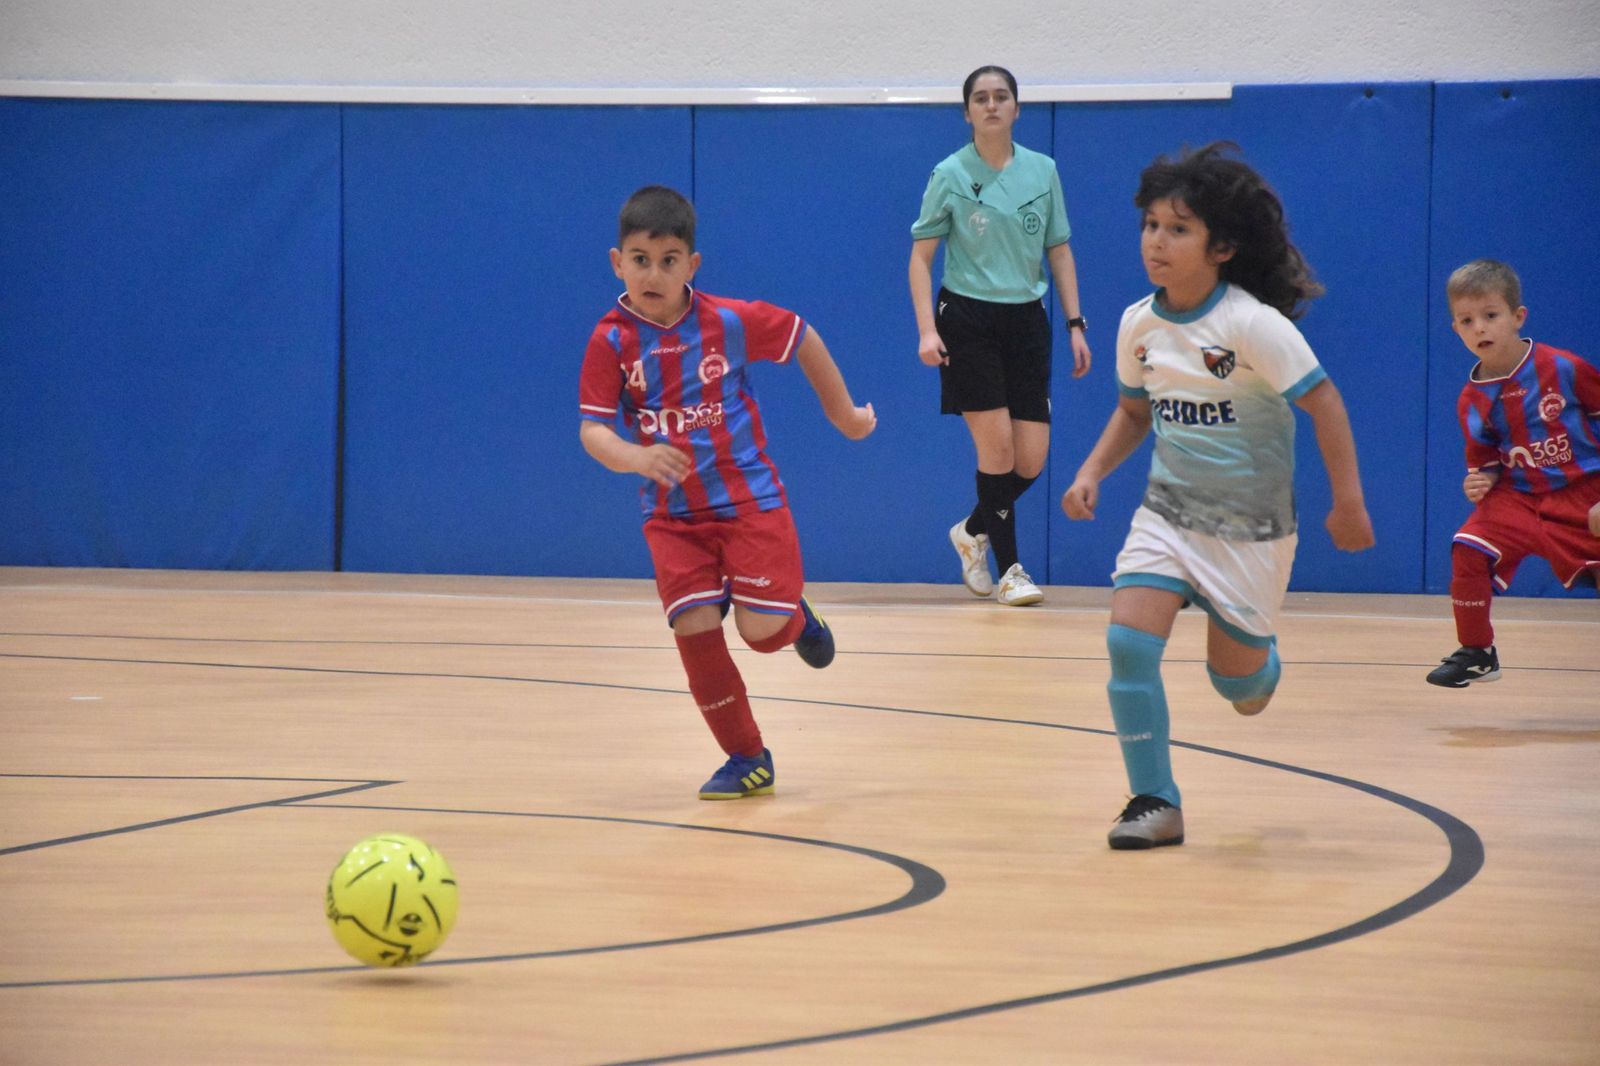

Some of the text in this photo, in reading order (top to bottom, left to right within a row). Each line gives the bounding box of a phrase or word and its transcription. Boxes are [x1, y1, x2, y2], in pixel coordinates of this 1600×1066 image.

[682, 402, 722, 423] 365
[685, 413, 723, 431] energy
[1529, 433, 1569, 460] 365
[1535, 449, 1573, 468] energy
